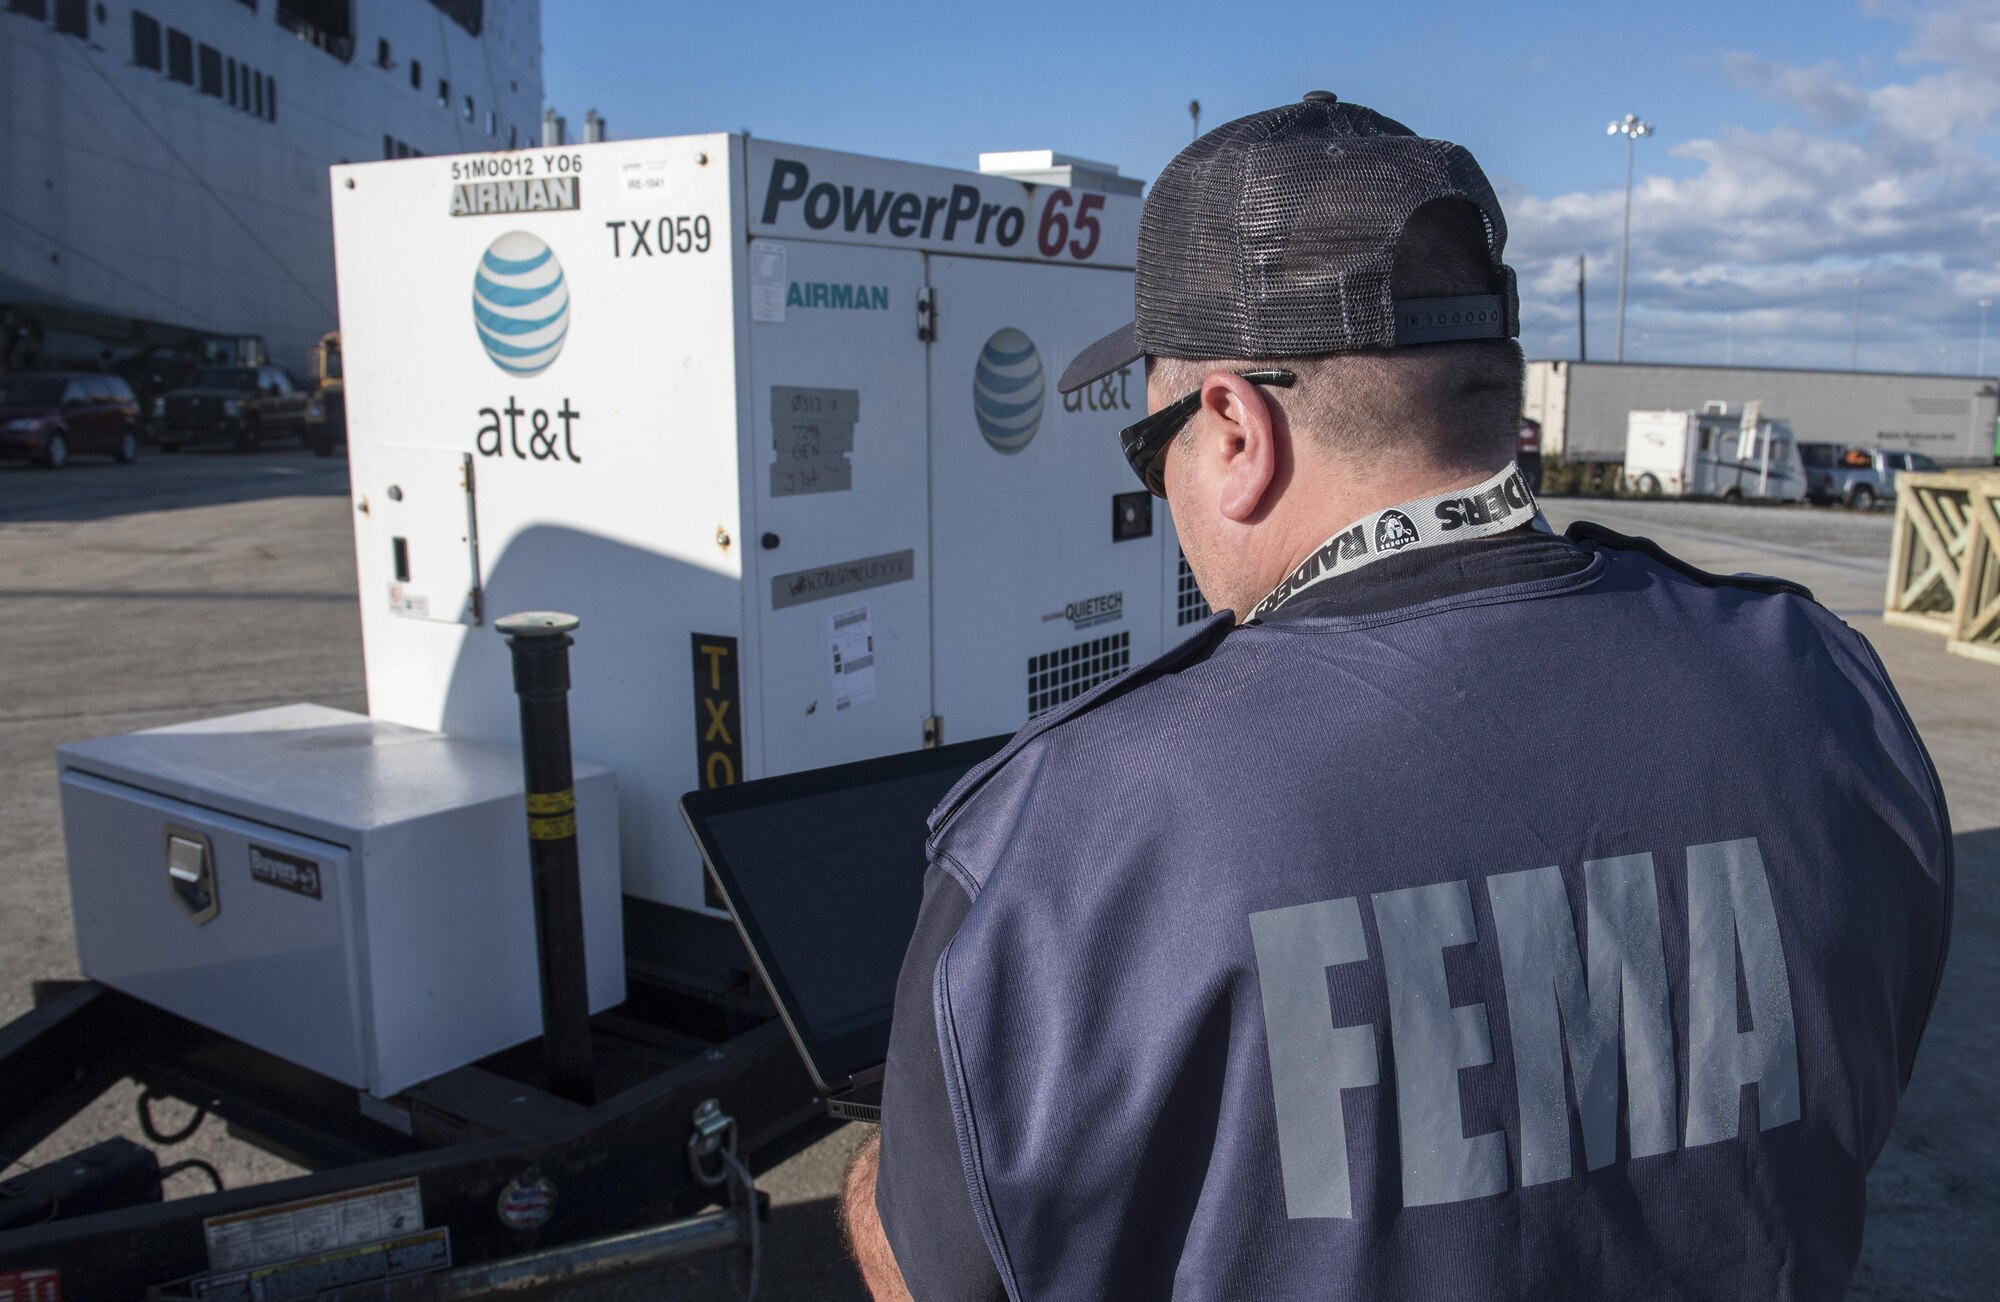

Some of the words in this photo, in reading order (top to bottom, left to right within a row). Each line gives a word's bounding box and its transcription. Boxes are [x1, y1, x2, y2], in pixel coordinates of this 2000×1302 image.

[449, 177, 576, 217] AIRMAN
[761, 158, 1025, 248] PowerPro
[1037, 188, 1106, 260] 65
[606, 214, 711, 258] TX059
[786, 281, 889, 311] AIRMAN
[476, 395, 582, 464] at&t
[1380, 536, 1416, 551] RAIDERS
[1065, 591, 1123, 621] QUIETECH
[1248, 836, 1801, 1220] FEMA
